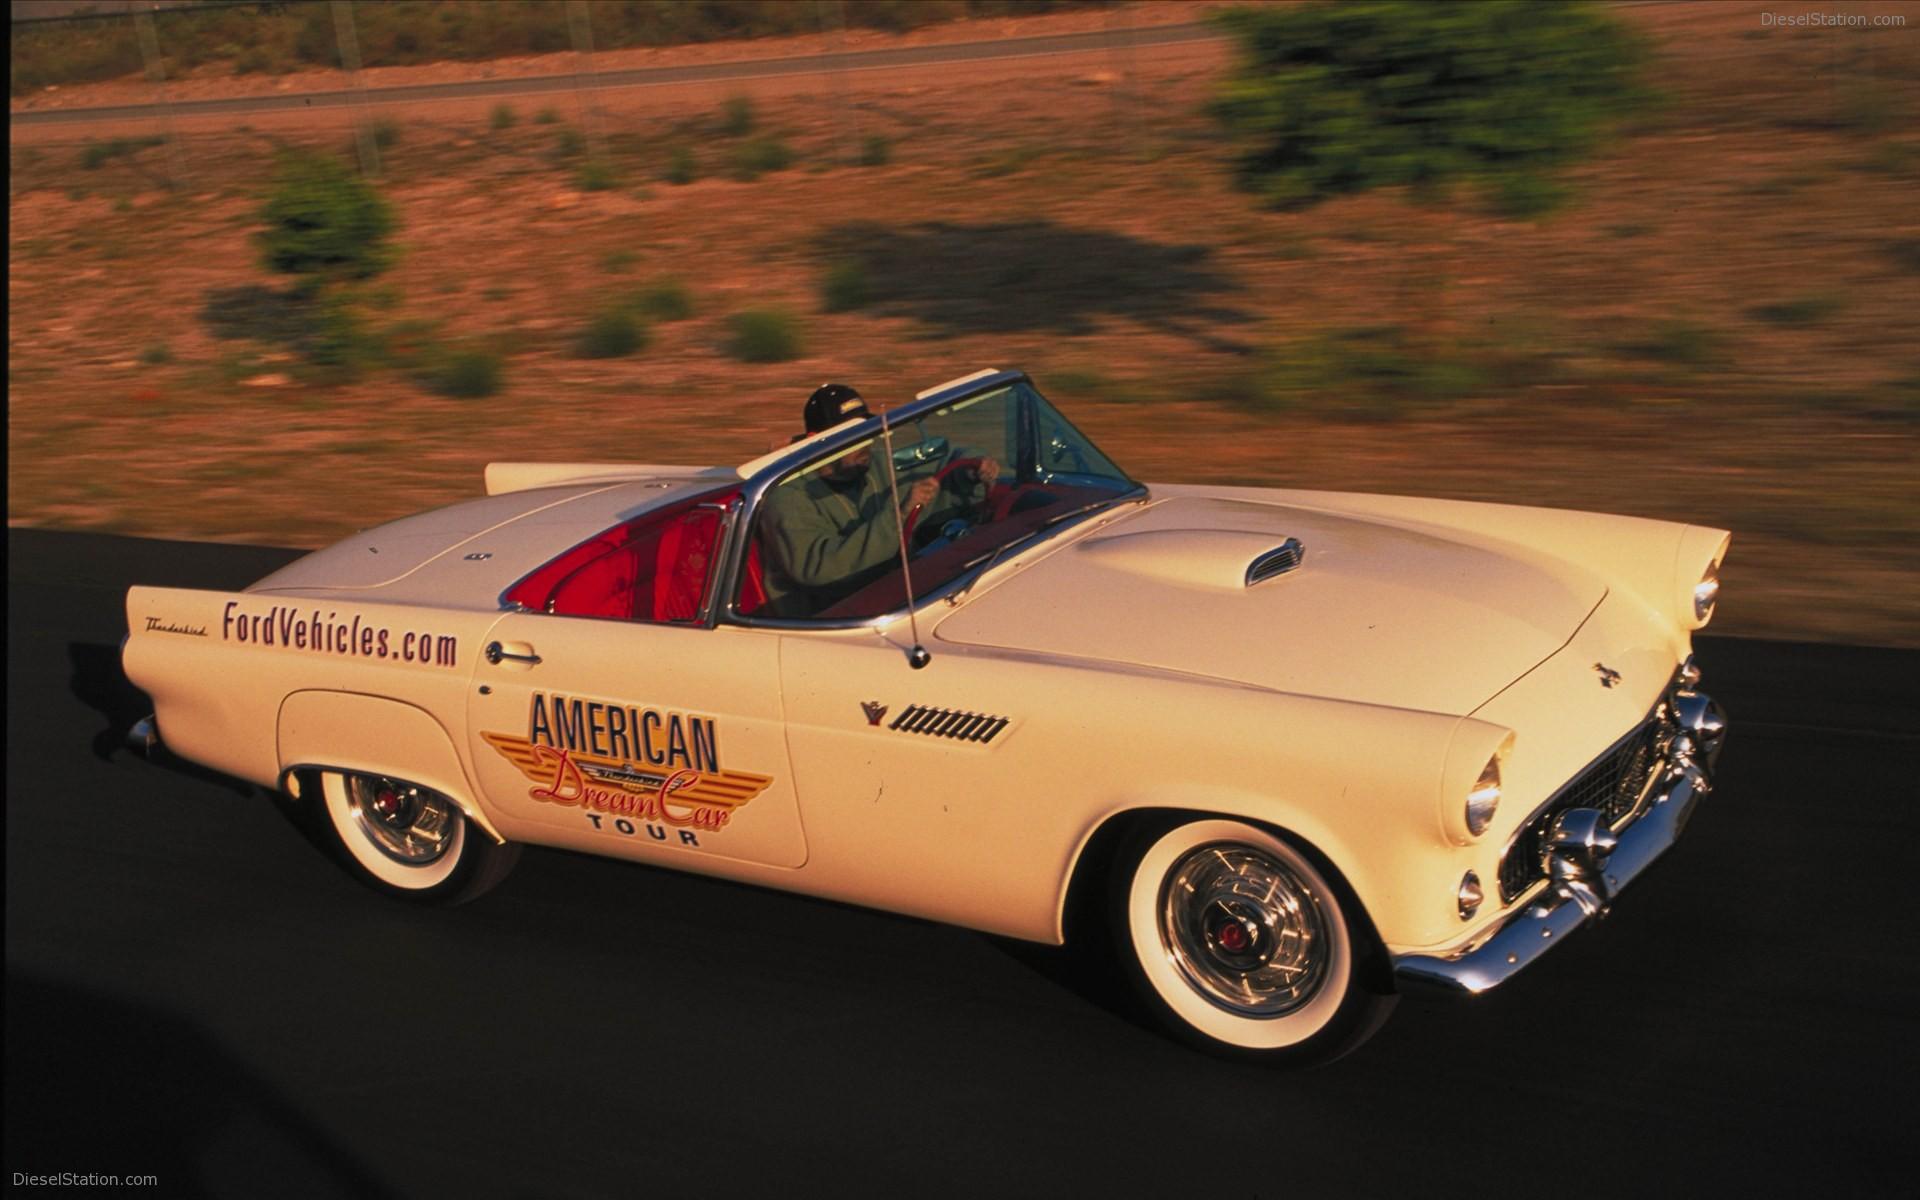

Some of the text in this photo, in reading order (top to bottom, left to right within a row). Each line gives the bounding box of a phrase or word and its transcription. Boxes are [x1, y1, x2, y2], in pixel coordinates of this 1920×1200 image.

[223, 601, 458, 667] FordVehicles.com
[531, 693, 719, 774] AMERICAN
[530, 744, 729, 827] Dream Car
[587, 813, 700, 847] TOUR
